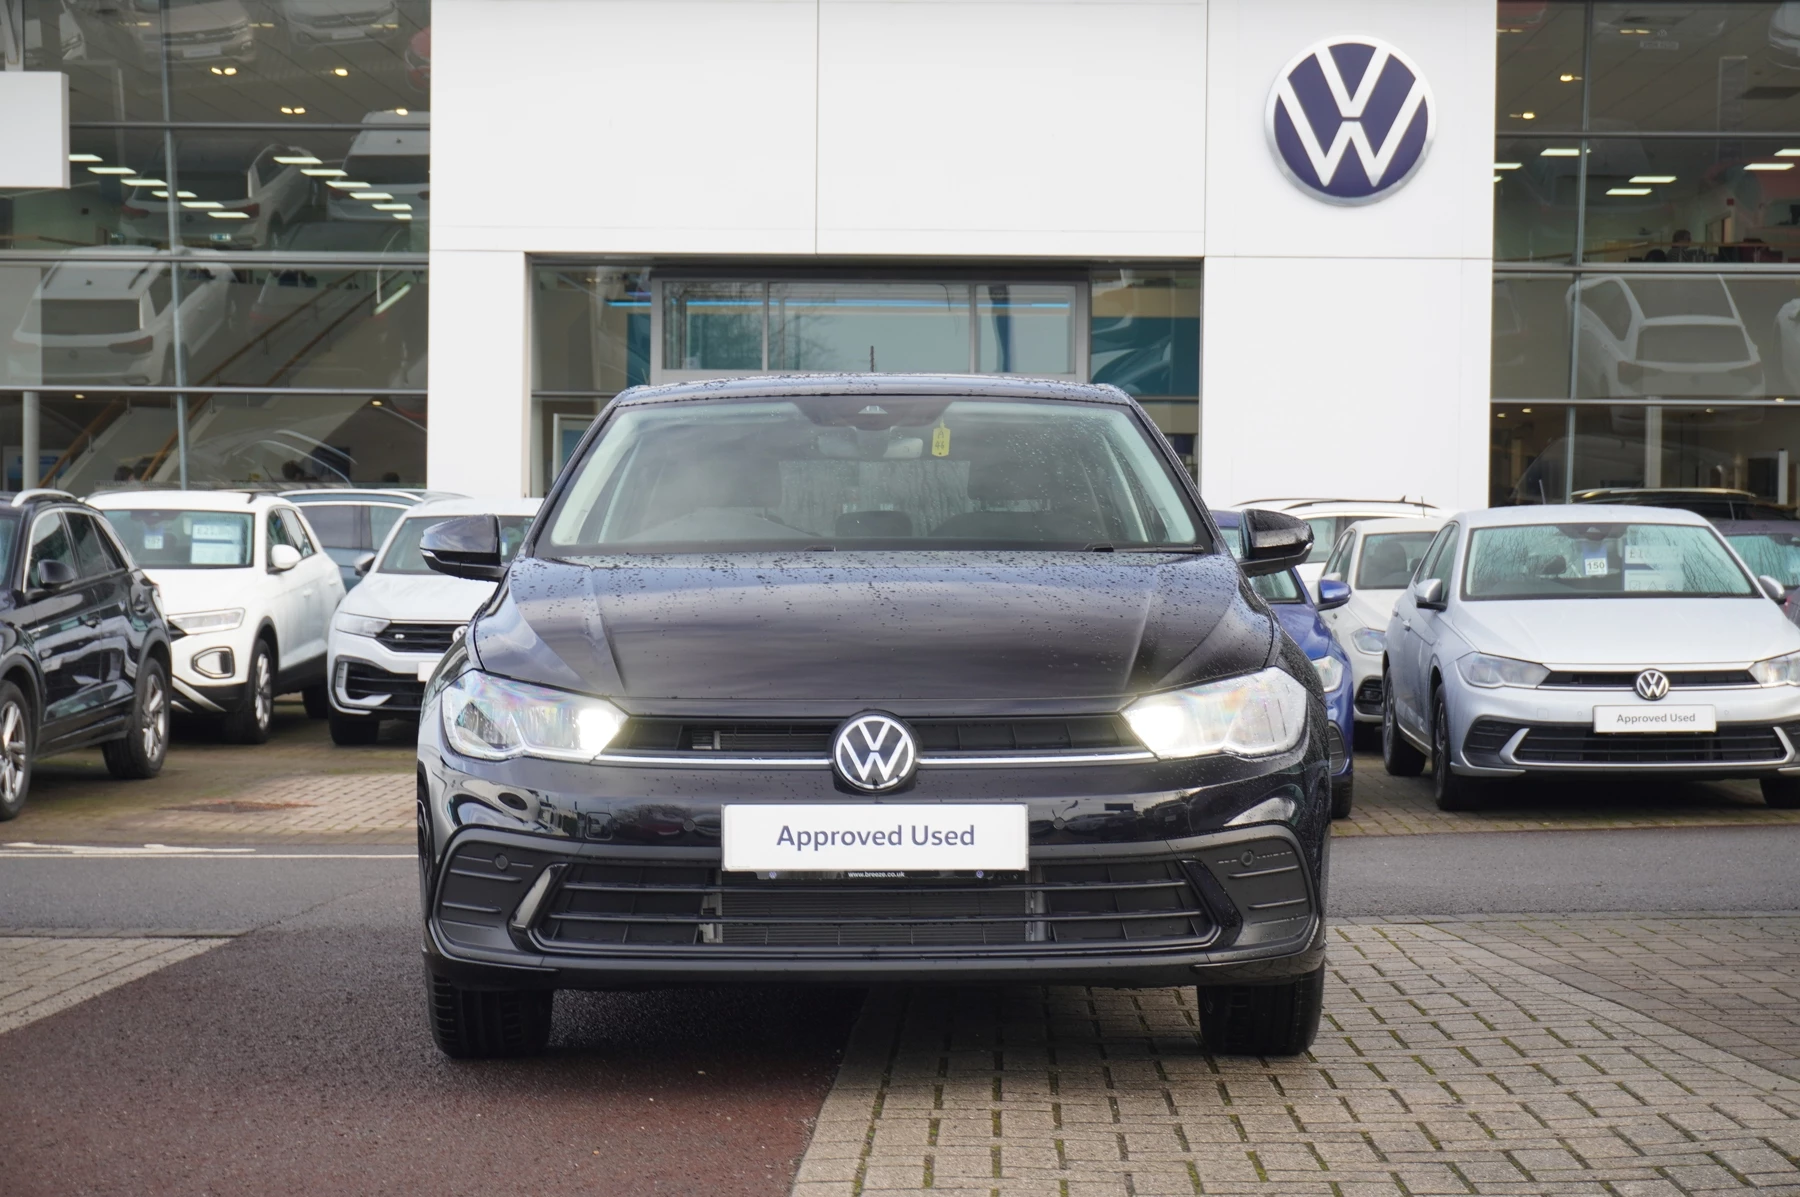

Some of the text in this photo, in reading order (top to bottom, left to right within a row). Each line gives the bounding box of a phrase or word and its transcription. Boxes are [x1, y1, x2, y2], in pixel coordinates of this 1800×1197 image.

[1272, 41, 1428, 188] VW
[1587, 561, 1605, 570] 150
[1616, 713, 1696, 724] Approved Used
[837, 716, 912, 785] VW
[776, 825, 976, 851] Approved Used
